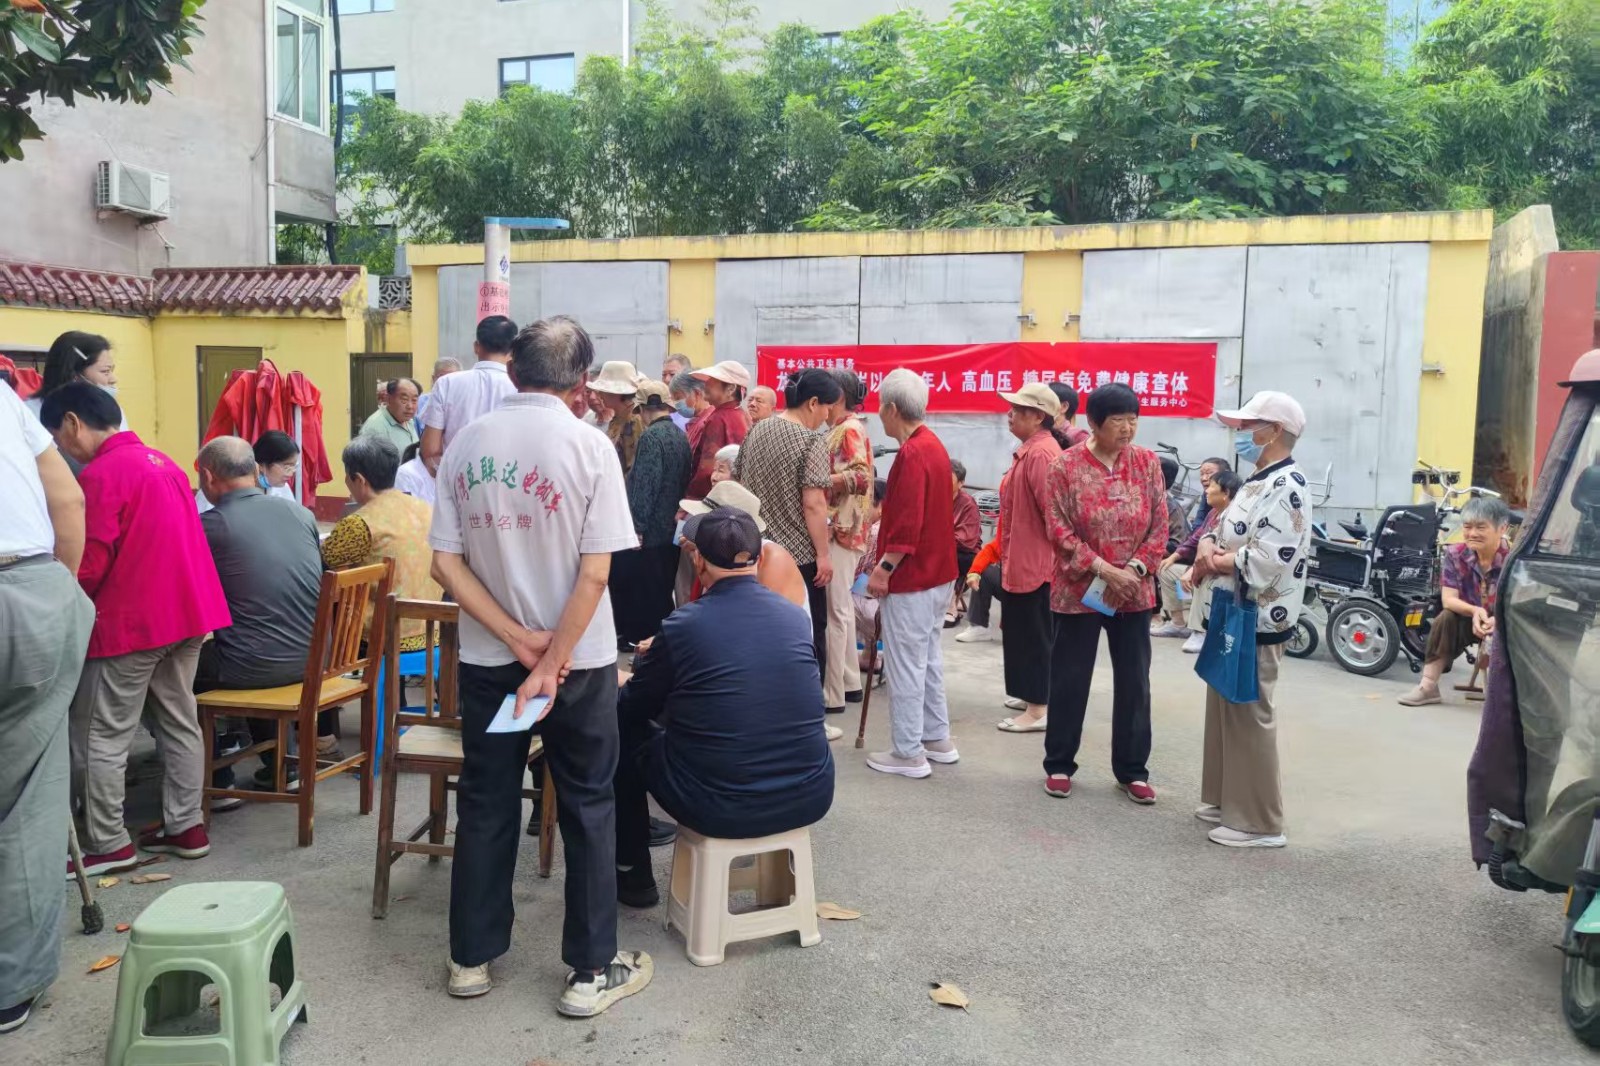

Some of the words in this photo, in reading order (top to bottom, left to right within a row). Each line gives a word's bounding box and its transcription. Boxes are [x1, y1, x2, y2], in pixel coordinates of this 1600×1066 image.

[776, 358, 855, 370] 基本公共卫生服务
[961, 369, 1013, 393] 高血压
[1022, 369, 1189, 396] 糖尿病免费健康查体
[1137, 396, 1188, 408] 生服务中心
[468, 512, 533, 531] 世界名牌
